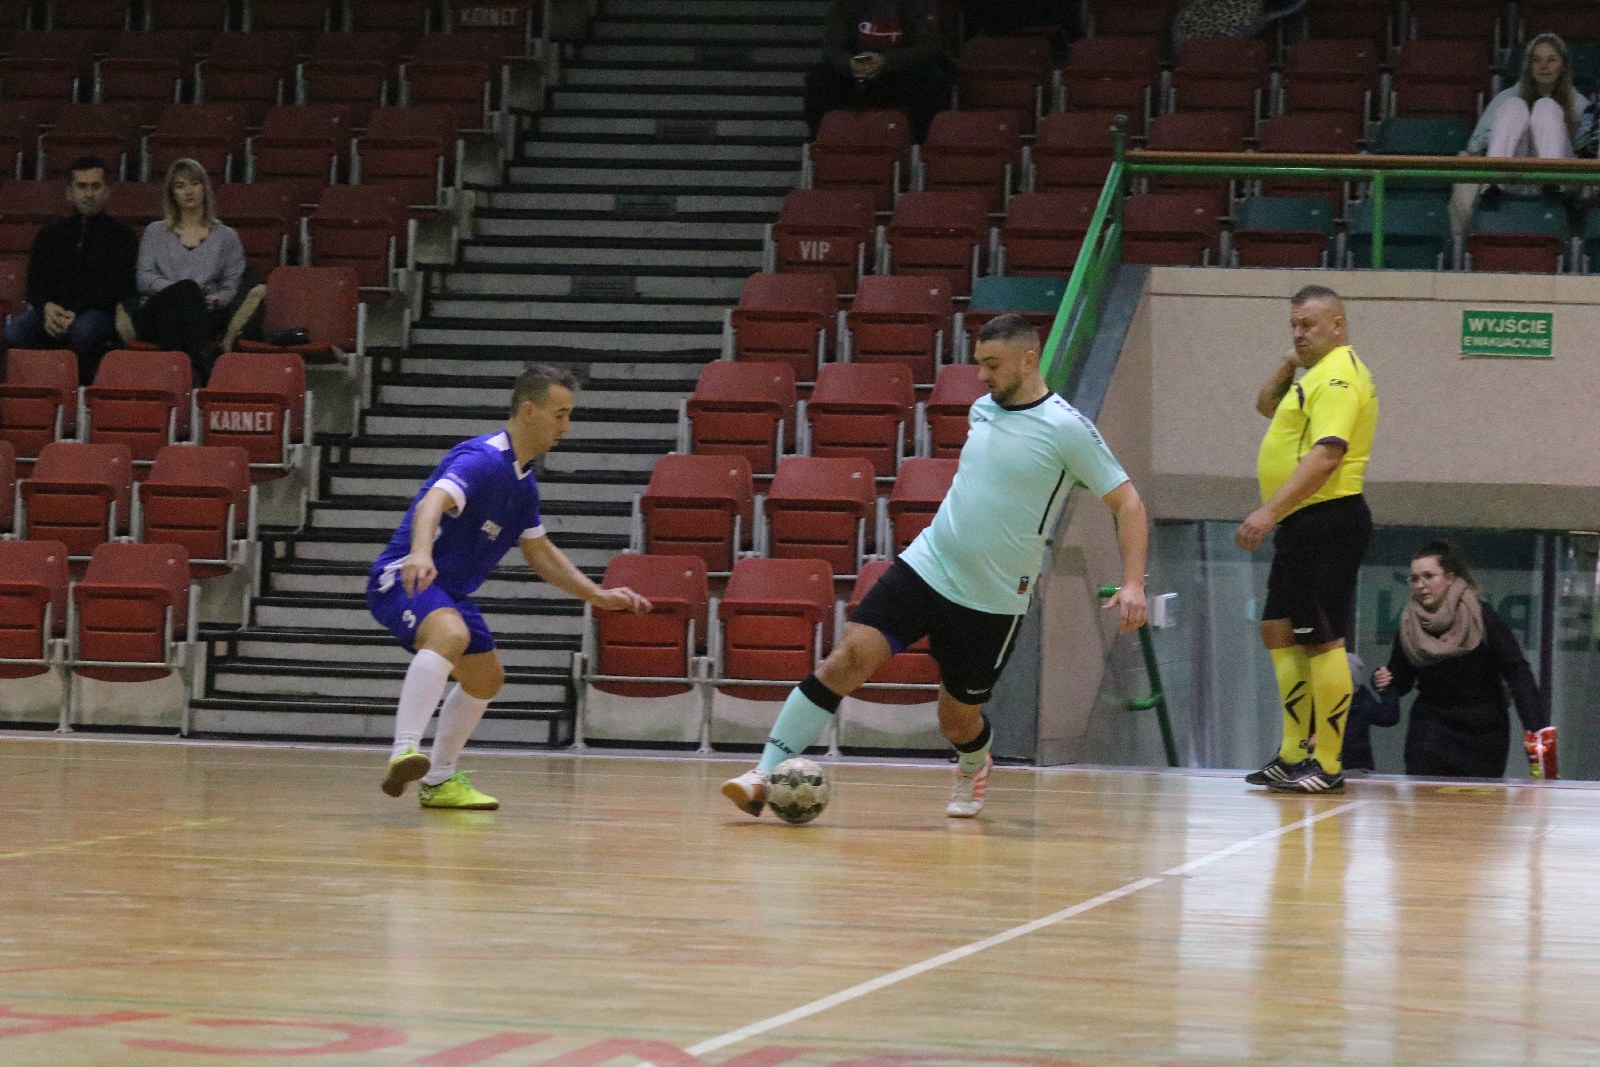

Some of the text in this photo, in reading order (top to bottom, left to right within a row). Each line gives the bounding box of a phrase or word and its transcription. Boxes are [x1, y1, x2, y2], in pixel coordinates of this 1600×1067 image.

[461, 7, 518, 26] KARNET
[799, 240, 831, 261] VIP
[1468, 316, 1547, 334] WYJŚCIE
[210, 410, 274, 432] KARNET
